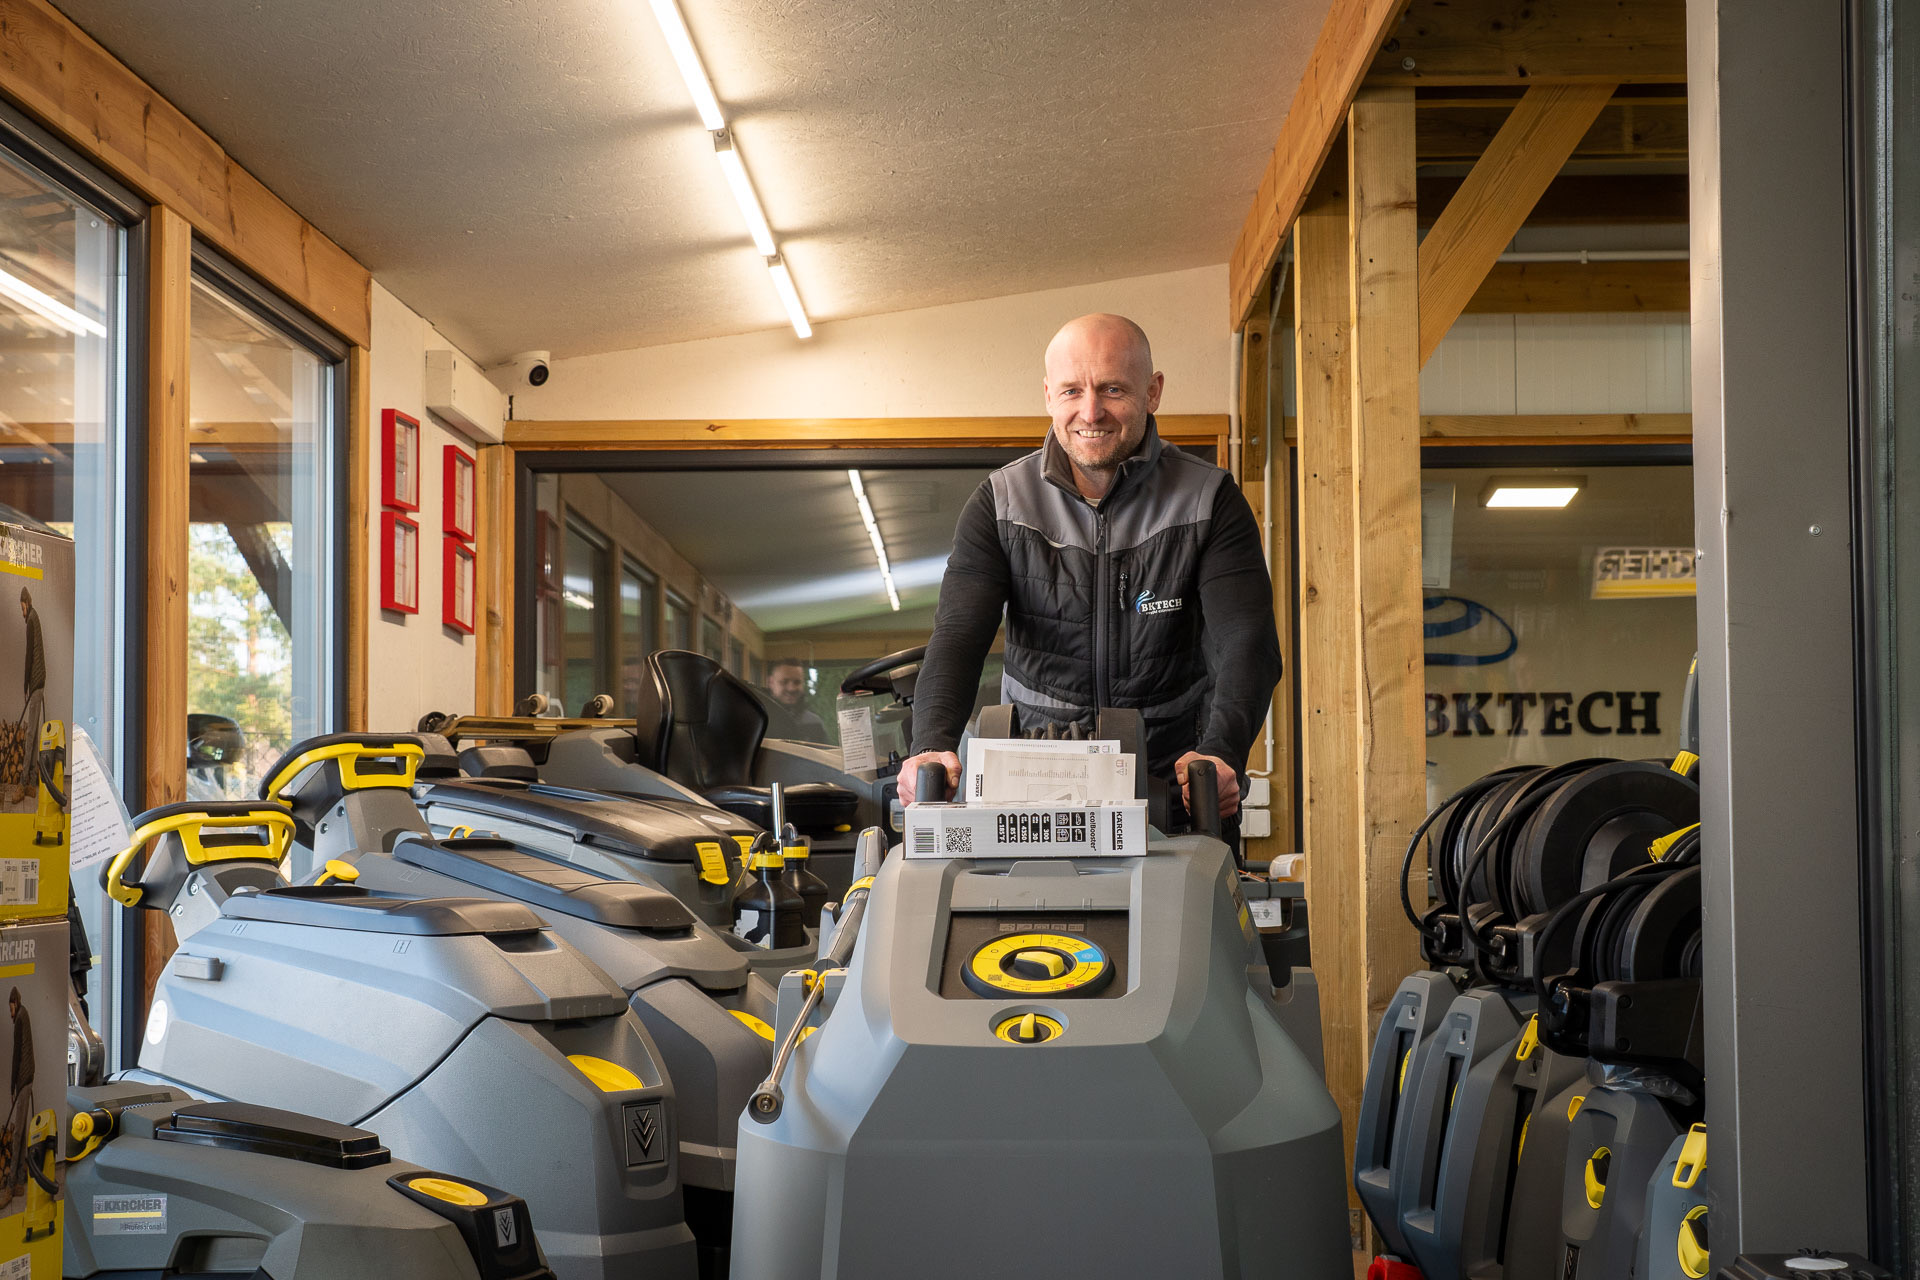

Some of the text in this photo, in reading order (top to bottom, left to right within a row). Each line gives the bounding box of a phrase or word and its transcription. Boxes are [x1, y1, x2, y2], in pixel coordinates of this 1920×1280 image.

[1141, 598, 1183, 613] BKTECH
[1425, 691, 1661, 736] BKTECH
[1032, 832, 1039, 840] 30
[0, 938, 36, 961] RCHER
[104, 1199, 162, 1212] KÄRCHER
